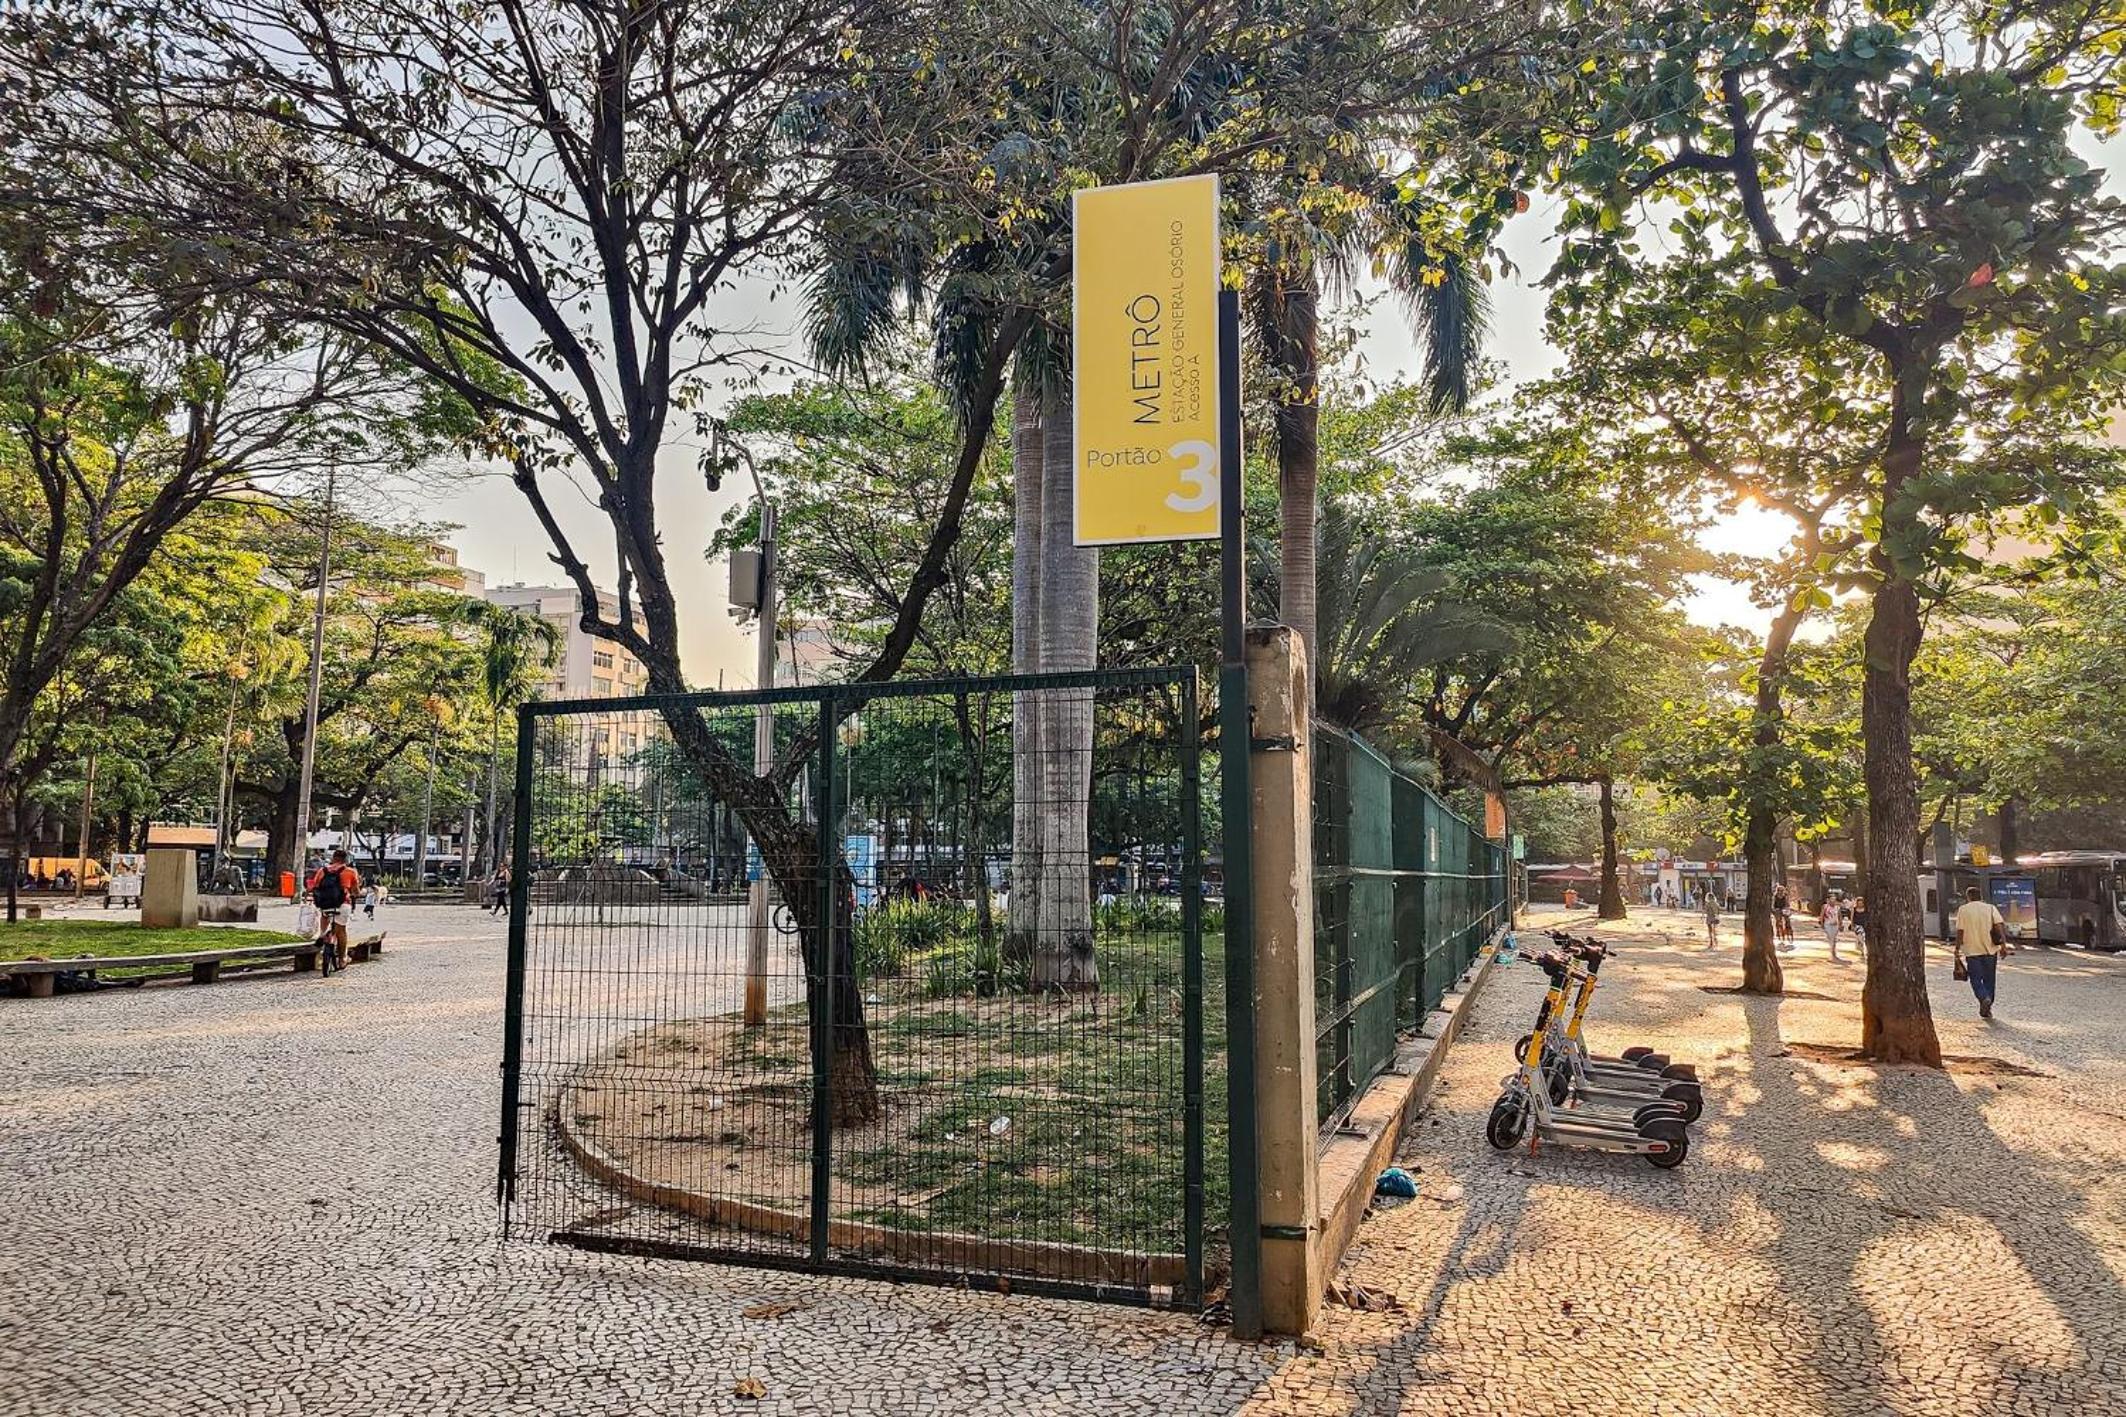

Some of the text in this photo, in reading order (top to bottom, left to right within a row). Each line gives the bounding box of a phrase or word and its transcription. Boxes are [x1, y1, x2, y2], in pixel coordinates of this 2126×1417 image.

[1169, 220, 1187, 423] ESTAÇÃO GENERAL OSÓRIO
[1125, 294, 1160, 424] METRÔ
[1188, 354, 1200, 421] Acesso A
[1087, 447, 1162, 468] Portão
[1165, 440, 1217, 513] 3
